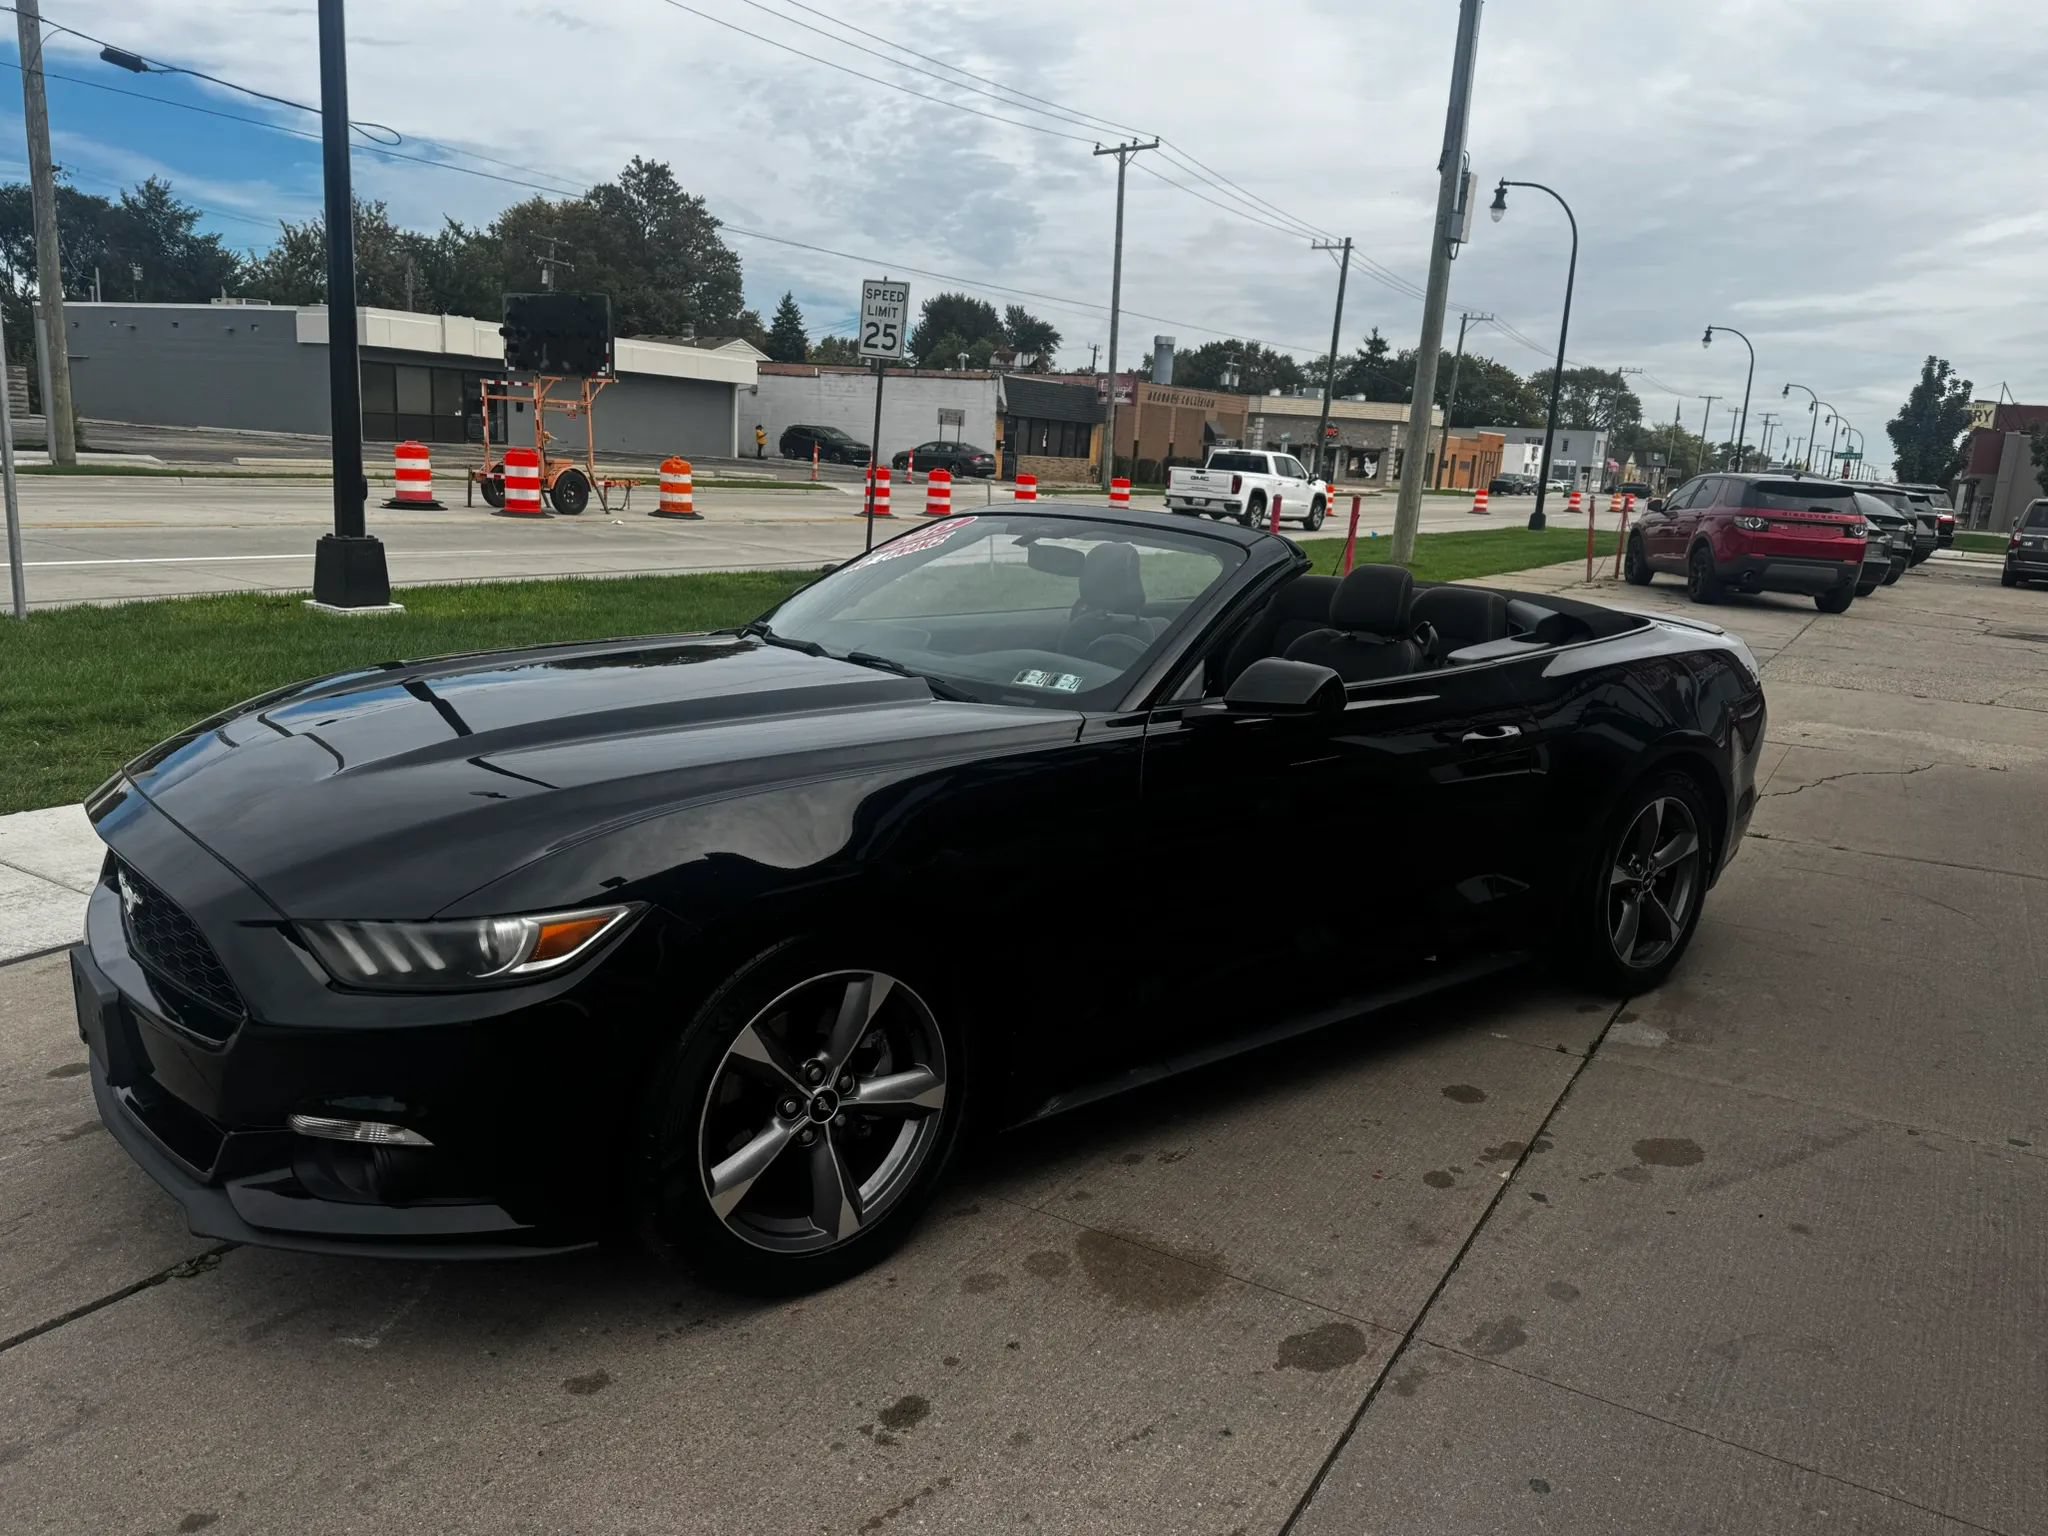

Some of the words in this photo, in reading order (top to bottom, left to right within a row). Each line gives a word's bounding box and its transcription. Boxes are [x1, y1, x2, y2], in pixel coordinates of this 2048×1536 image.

[866, 288, 905, 303] SPEED
[867, 304, 899, 319] LIMIT
[863, 322, 897, 351] 25
[1181, 395, 1215, 408] COLLISION
